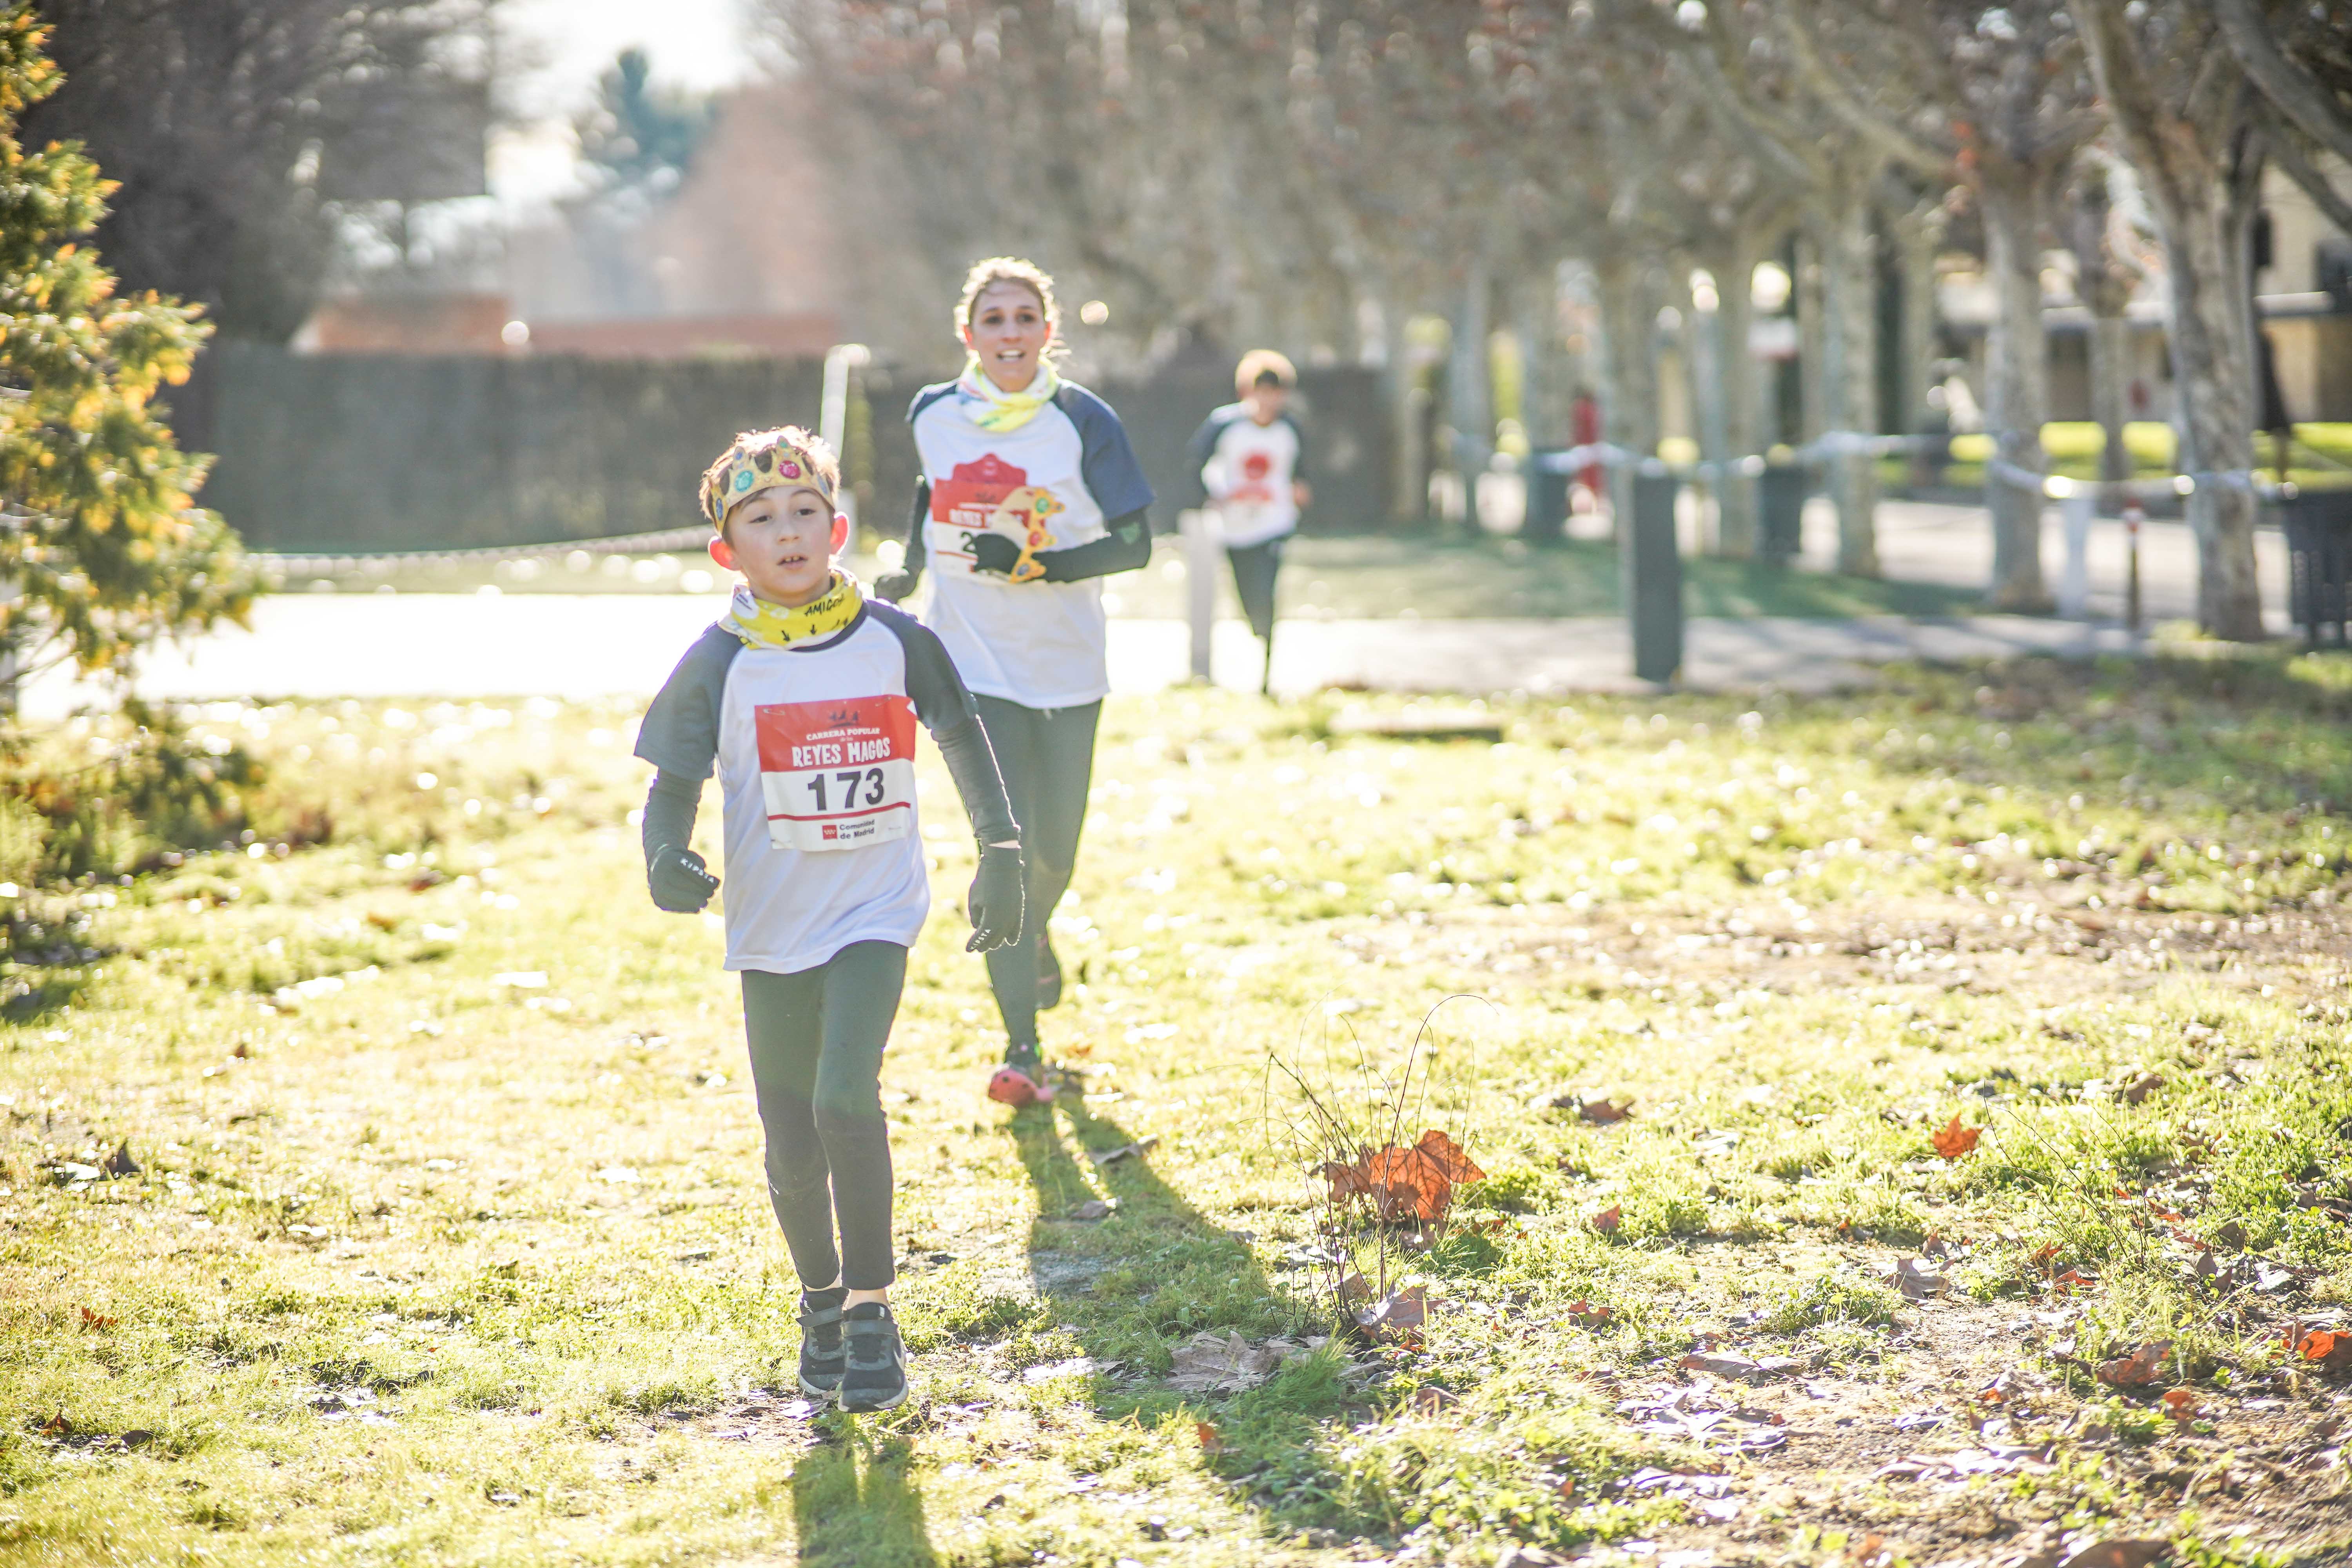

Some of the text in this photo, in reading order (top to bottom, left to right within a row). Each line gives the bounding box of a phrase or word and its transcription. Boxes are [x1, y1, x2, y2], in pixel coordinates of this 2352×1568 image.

[806, 728, 880, 740] CARRERA POPULAR
[791, 737, 891, 767] REYES MAGOS
[808, 768, 884, 811] 173
[839, 819, 875, 831] Comunidad
[853, 828, 875, 838] Madrid
[680, 857, 714, 883] KIPSTA
